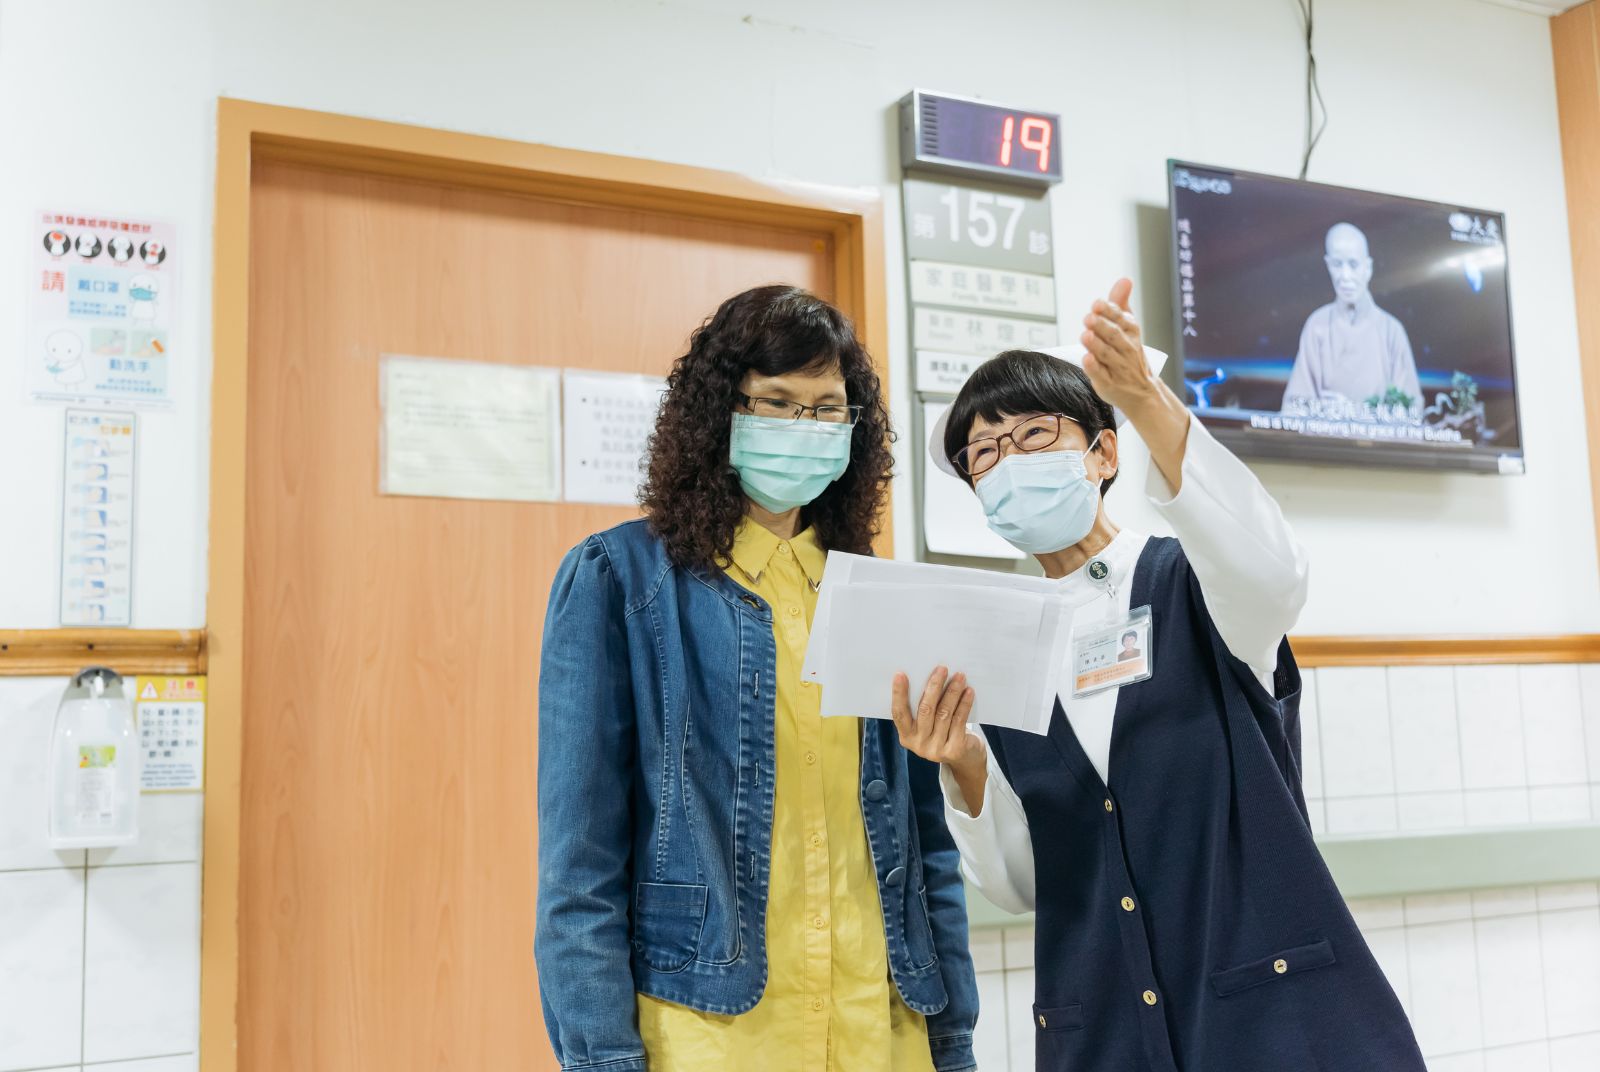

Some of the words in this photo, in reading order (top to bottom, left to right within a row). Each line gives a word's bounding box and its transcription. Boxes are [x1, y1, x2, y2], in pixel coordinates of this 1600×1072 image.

[1000, 115, 1051, 172] 19
[42, 270, 65, 293] 請
[925, 267, 1042, 297] 家庭醫學科
[1283, 417, 1304, 434] truly
